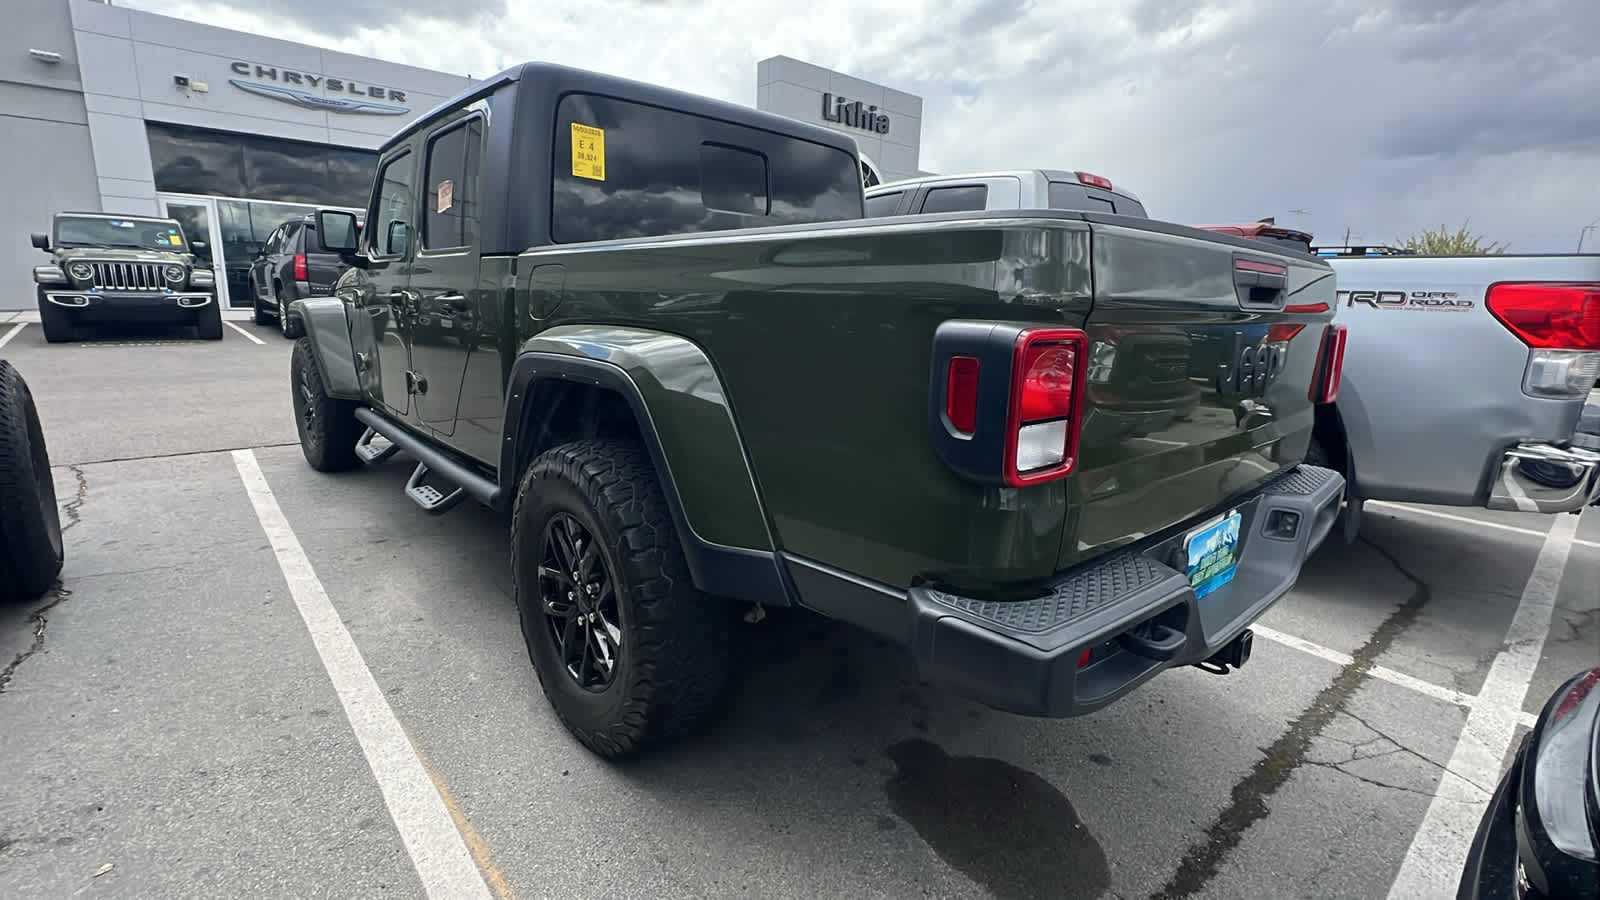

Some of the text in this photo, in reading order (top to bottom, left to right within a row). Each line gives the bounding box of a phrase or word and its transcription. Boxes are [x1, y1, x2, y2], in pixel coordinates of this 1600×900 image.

[231, 61, 406, 102] CHRYSLER
[823, 92, 890, 134] Lithia
[580, 140, 594, 151] E 4
[1409, 299, 1475, 309] ROAD
[1410, 291, 1459, 299] OFF
[1216, 331, 1285, 397] Jeep
